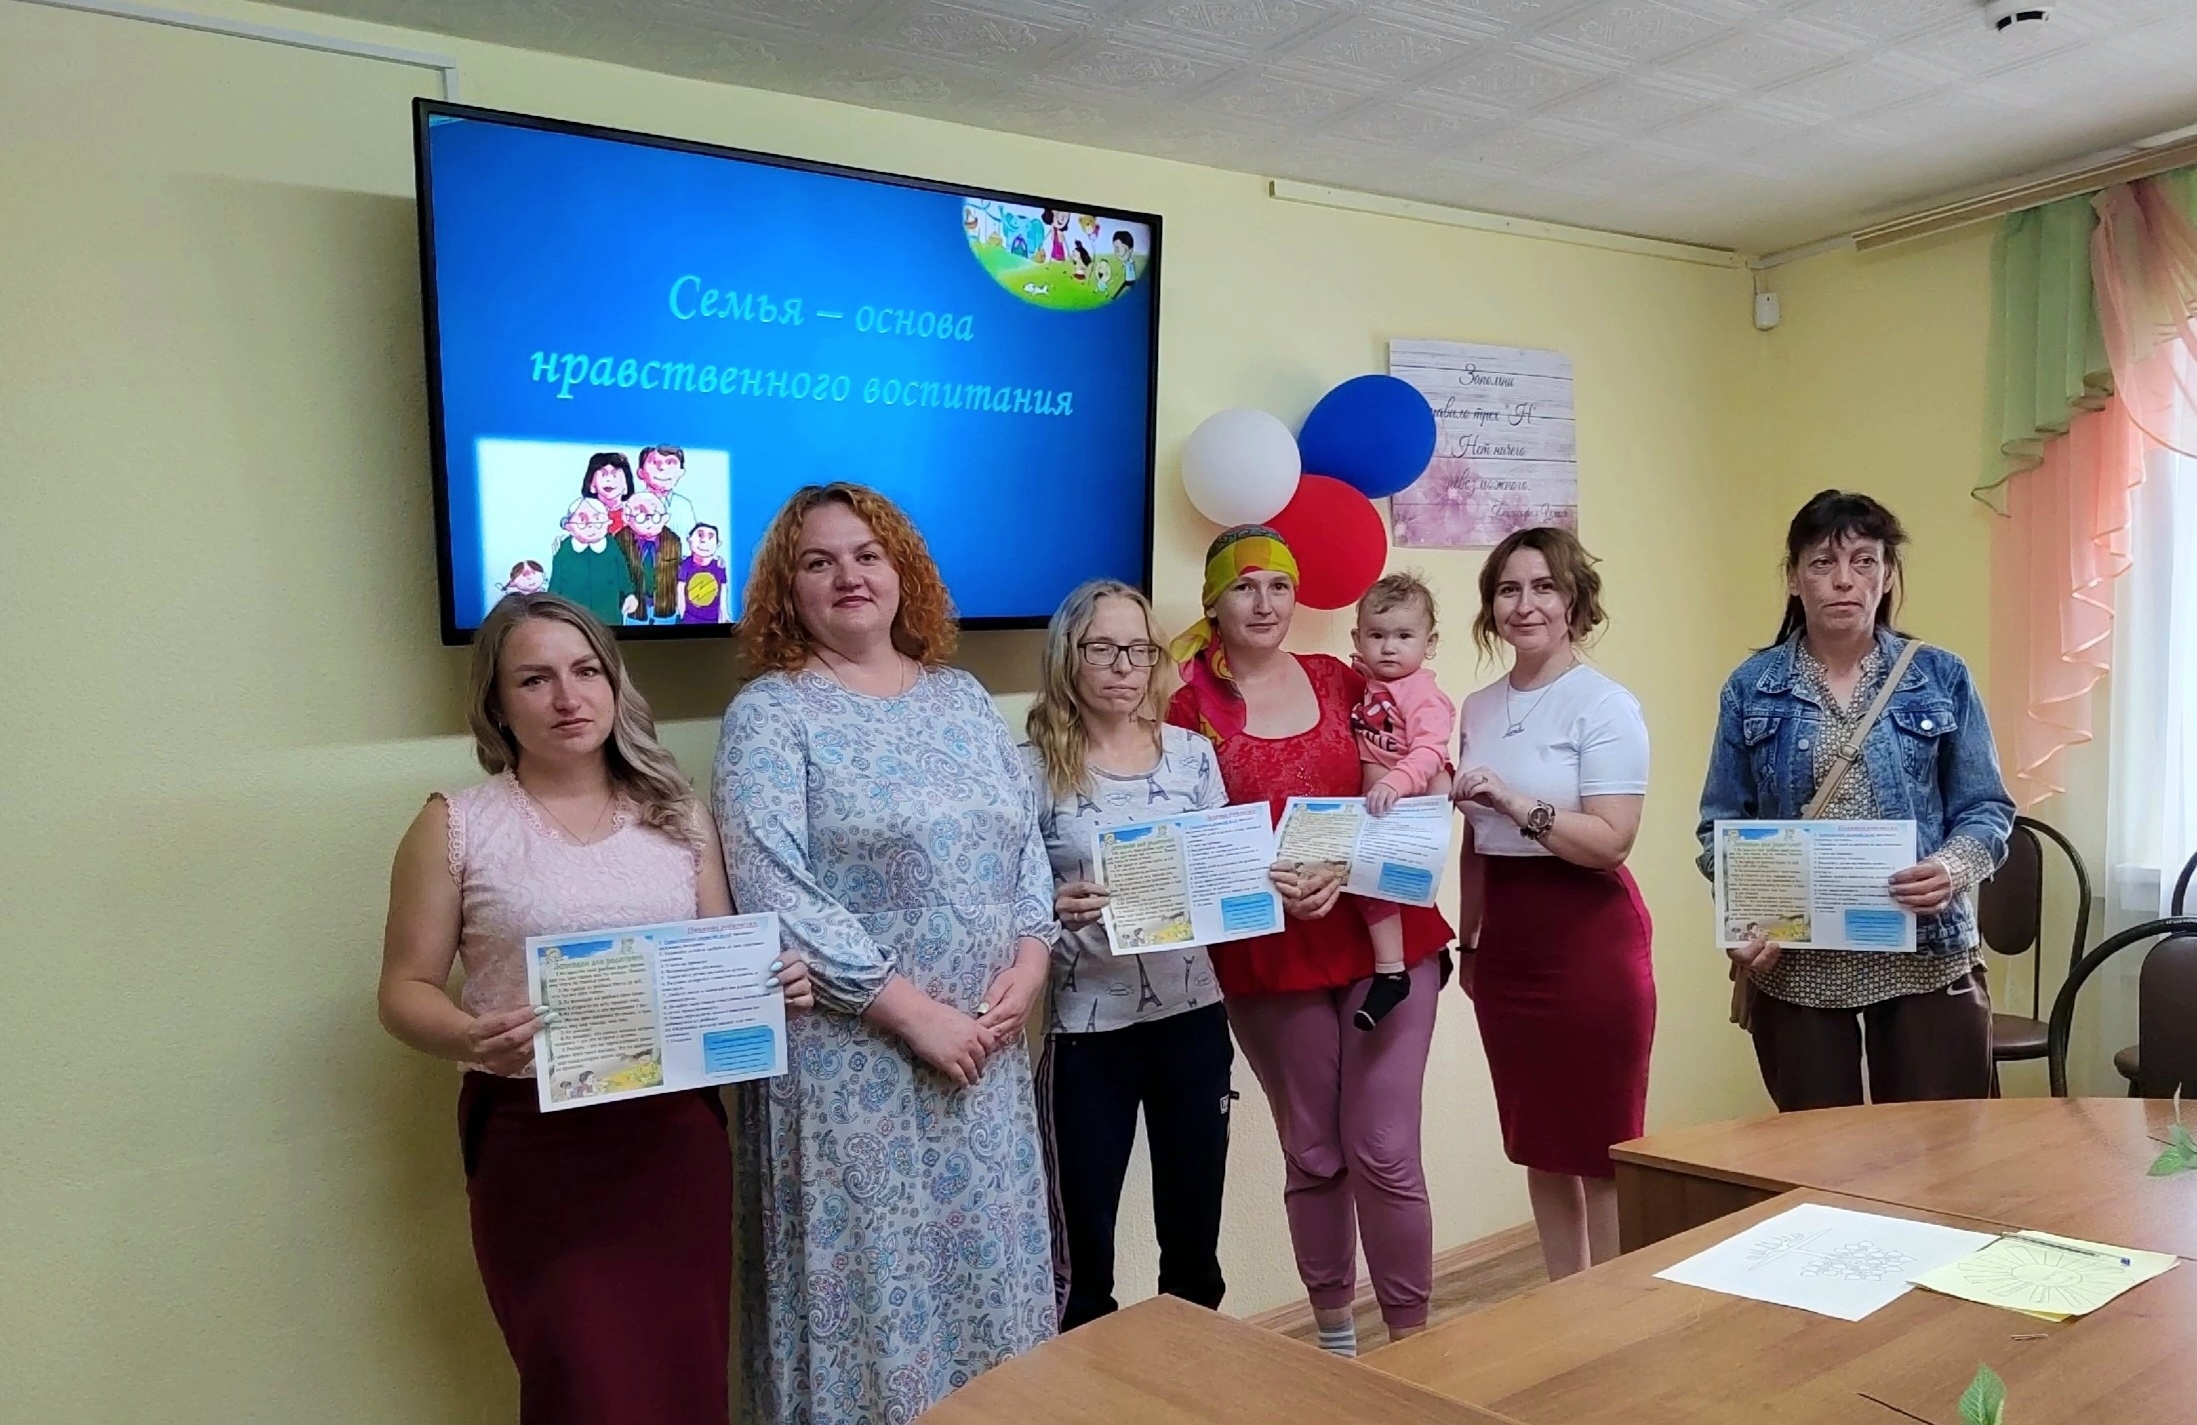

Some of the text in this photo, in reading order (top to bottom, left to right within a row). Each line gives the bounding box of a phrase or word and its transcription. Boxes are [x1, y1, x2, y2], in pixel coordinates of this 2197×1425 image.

[668, 274, 804, 325] Семья
[855, 304, 975, 341] основа
[530, 350, 1073, 416] нравственного воспитания
[1459, 363, 1514, 388] Запомни
[1493, 444, 1525, 456] ничего
